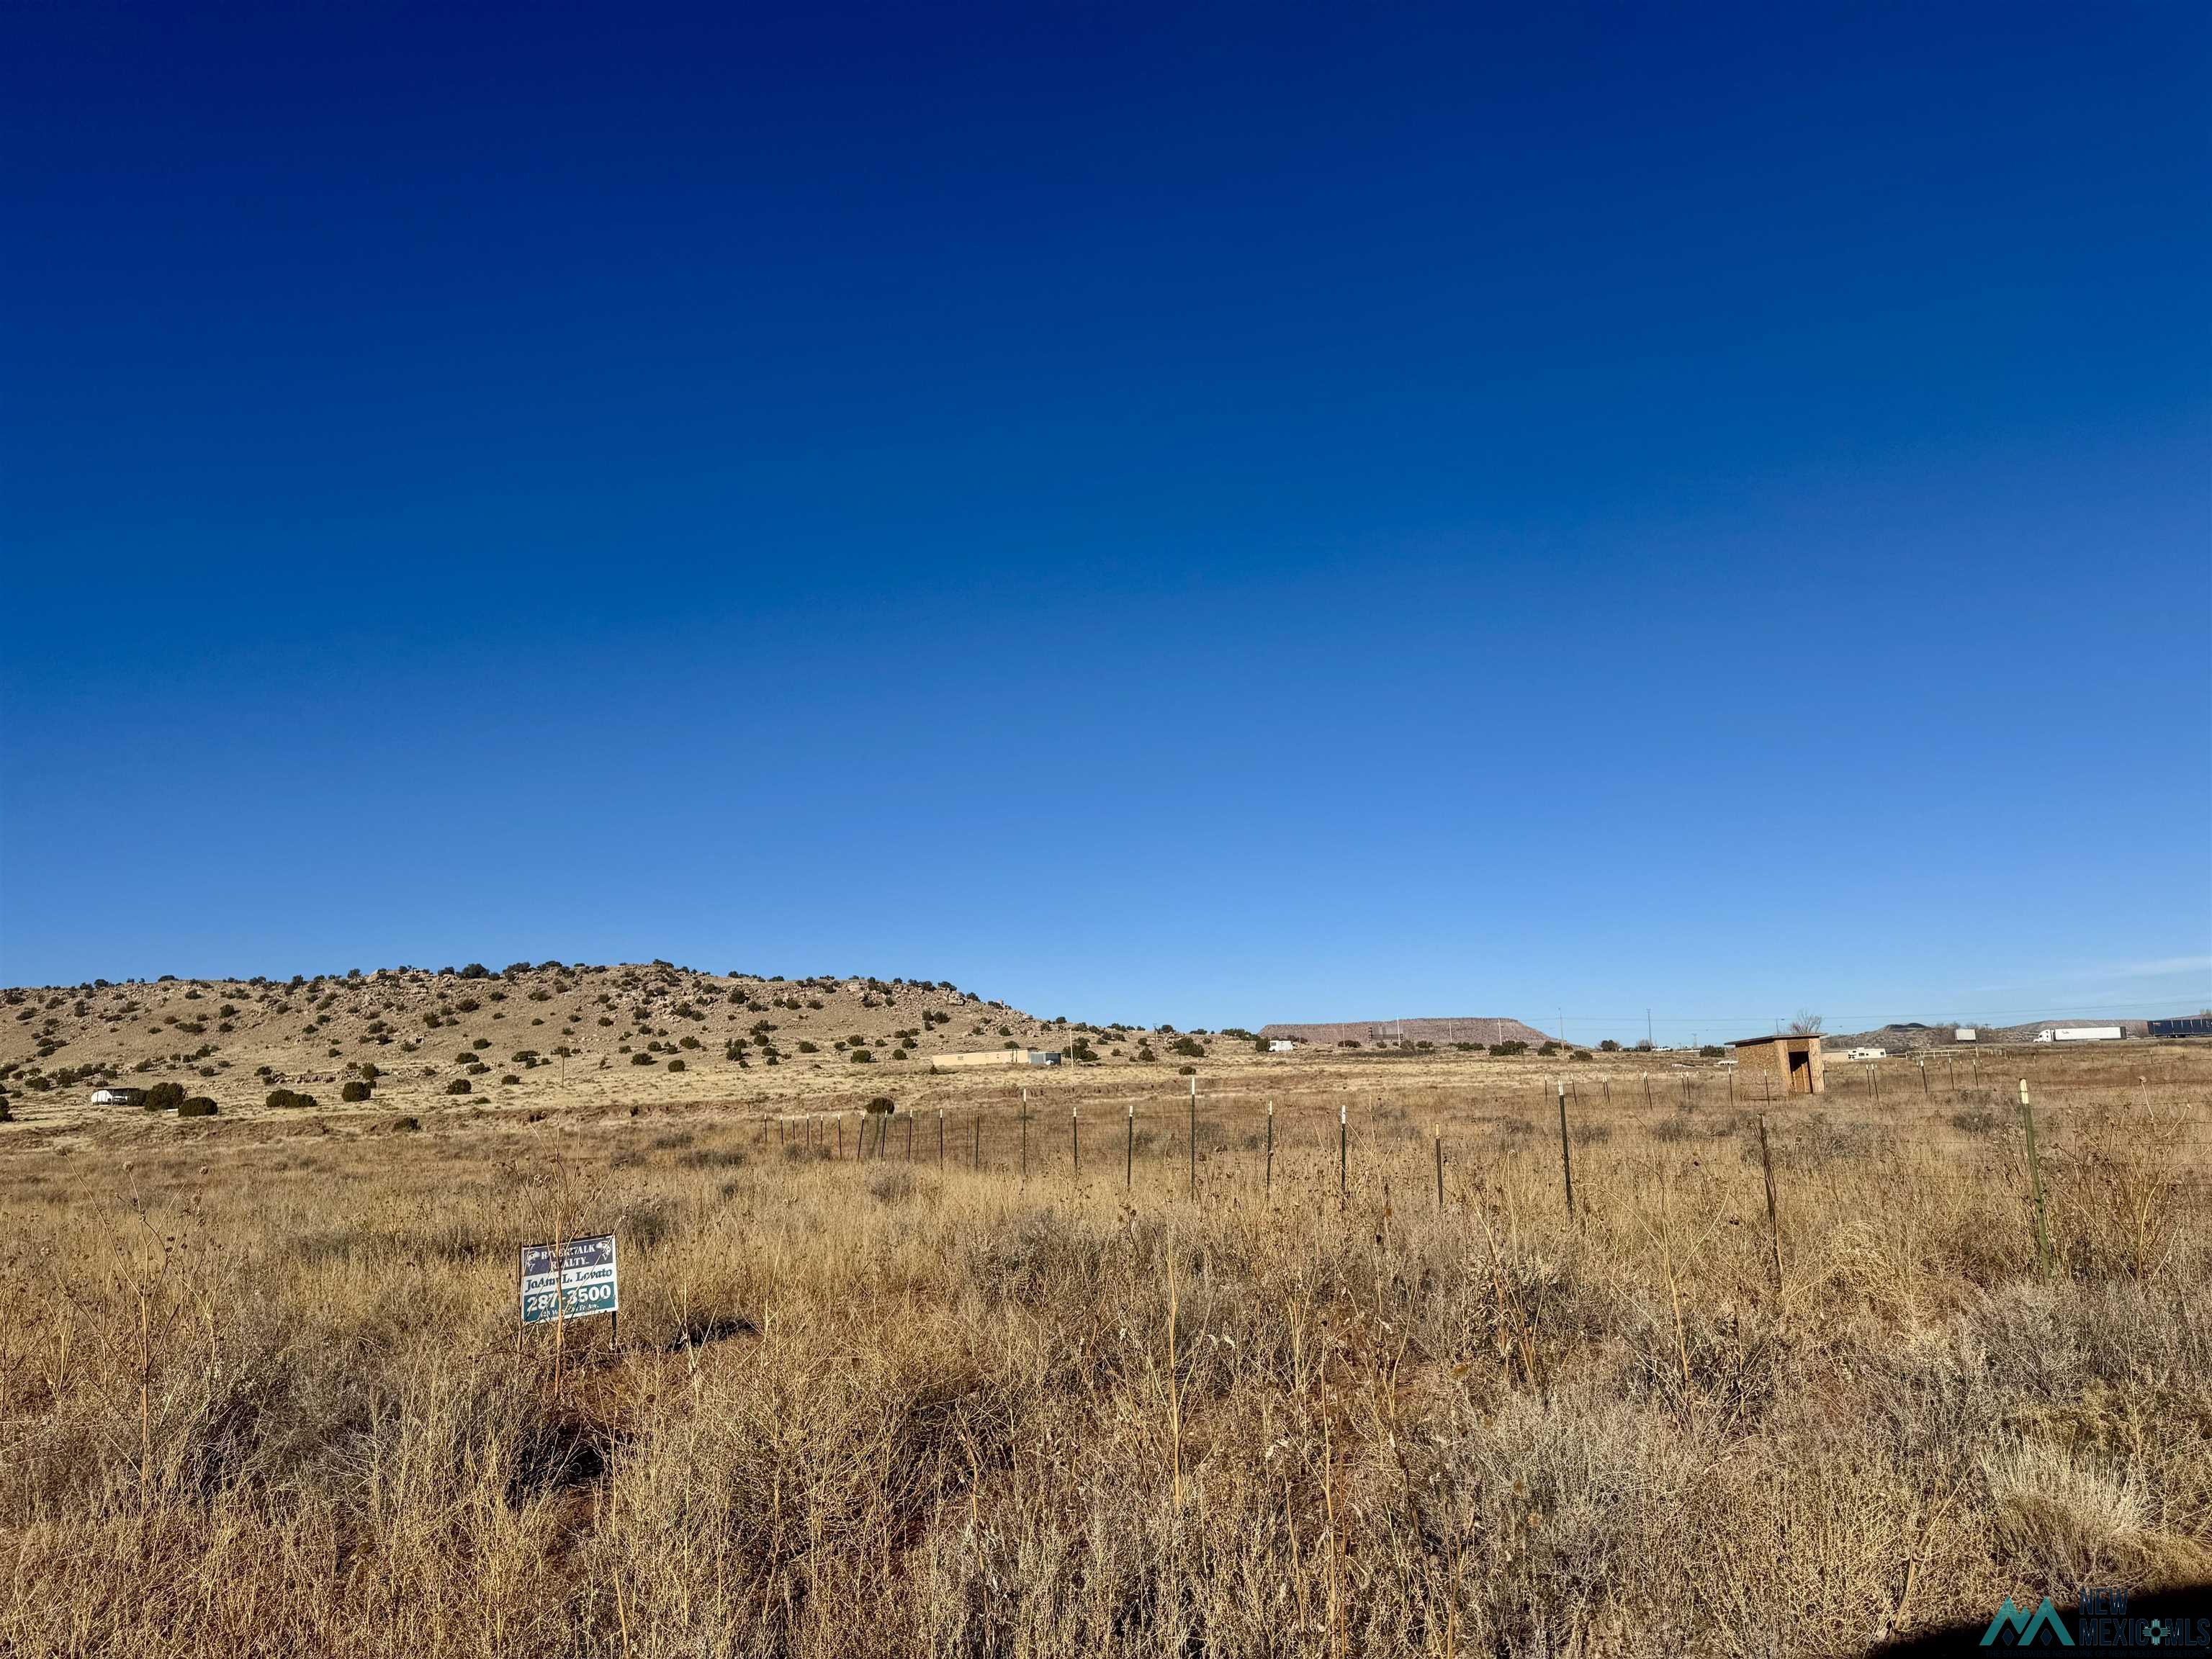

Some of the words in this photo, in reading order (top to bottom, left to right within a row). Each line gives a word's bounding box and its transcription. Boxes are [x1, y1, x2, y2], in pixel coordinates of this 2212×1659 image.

[541, 1244, 595, 1259] RVERWALK
[552, 1256, 588, 1269] RALTY
[562, 1274, 572, 1284] L.
[575, 1268, 613, 1282] Lovato
[526, 1285, 611, 1312] 287-3500
